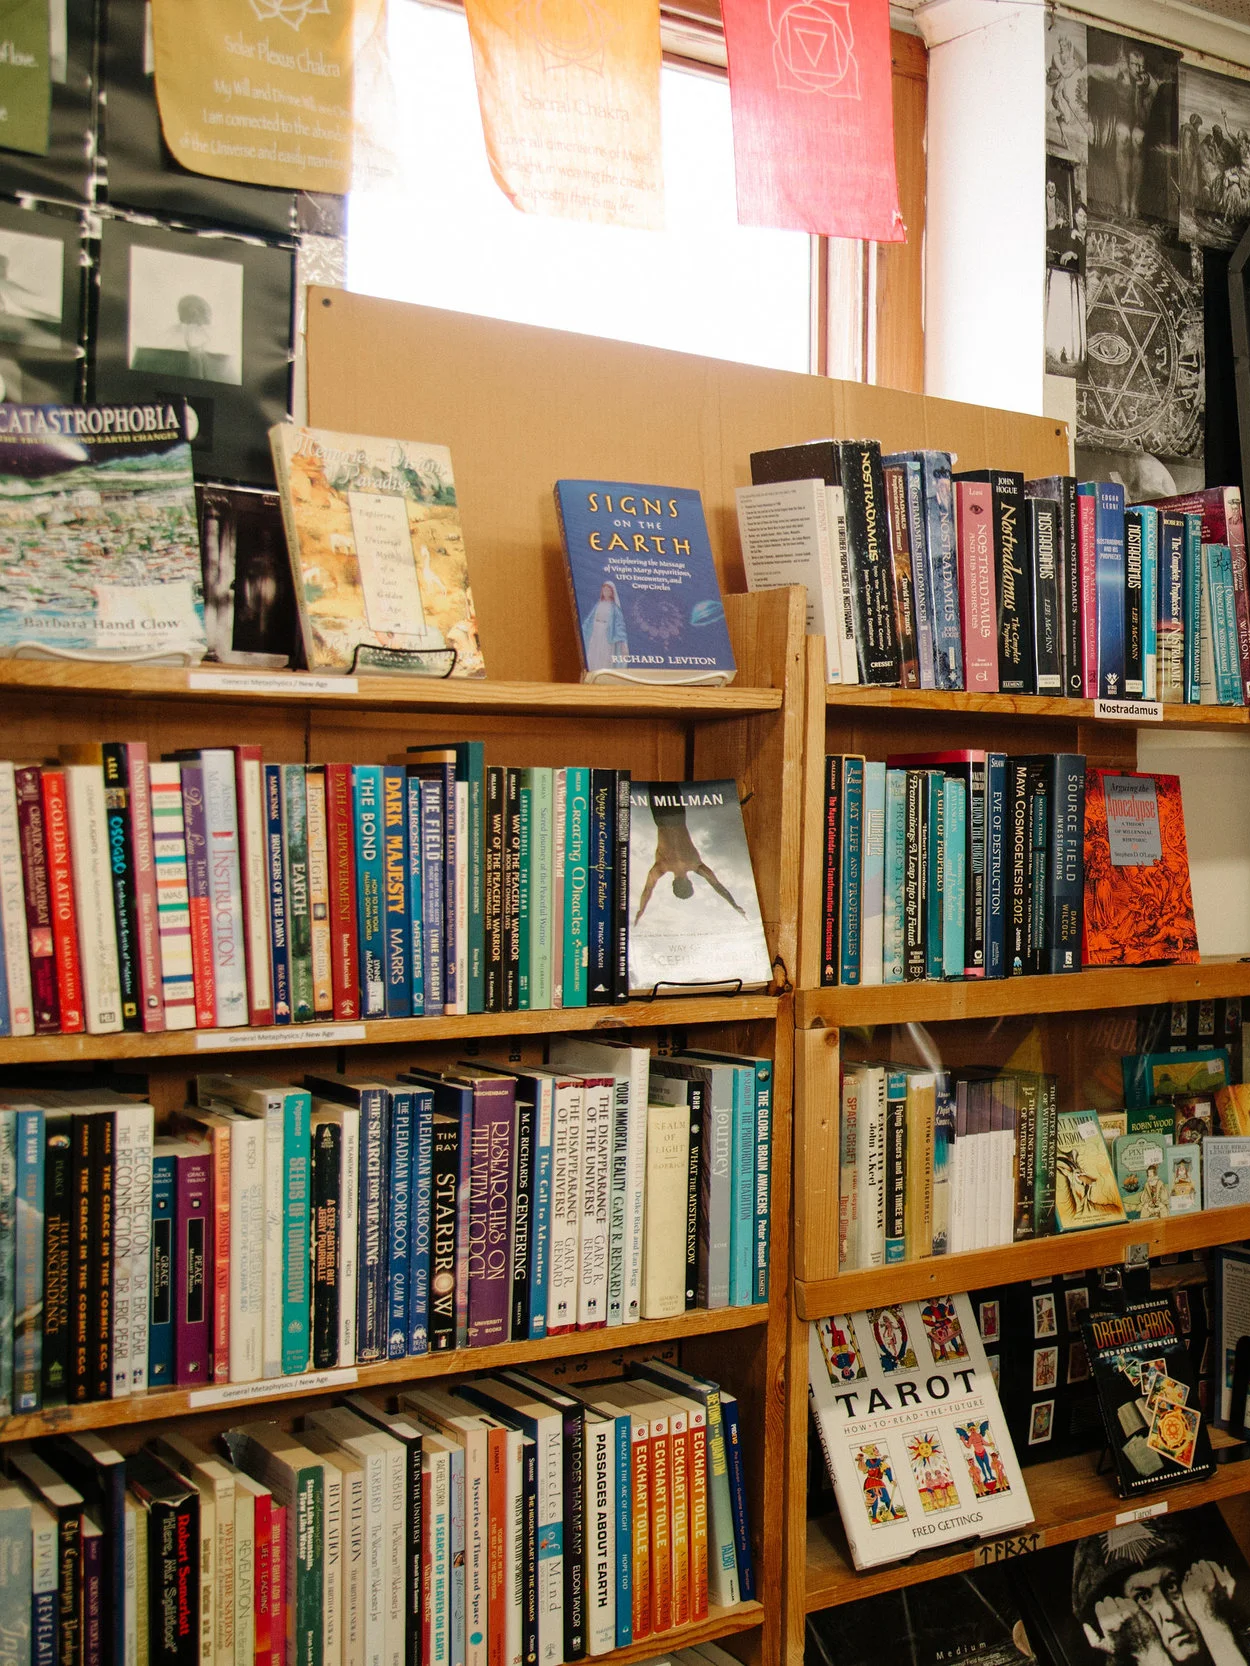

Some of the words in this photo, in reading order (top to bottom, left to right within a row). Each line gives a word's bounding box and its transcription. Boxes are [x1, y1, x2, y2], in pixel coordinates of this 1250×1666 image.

[296, 50, 341, 78] Chakra
[996, 485, 1018, 495] HOGUE
[998, 477, 1015, 485] JOHN
[587, 493, 679, 517] SIGNS
[860, 452, 879, 563] NOSTRADAMUS
[614, 519, 631, 528] ON
[638, 521, 662, 530] THE
[589, 532, 691, 556] EARTH
[1001, 501, 1023, 611] Nostradamus
[1038, 512, 1054, 580] NOSTRADAMUS
[648, 559, 658, 567] the
[659, 561, 685, 569] Message
[977, 524, 991, 638] NOSTRADAMUS
[23, 616, 87, 630] Barbara
[93, 618, 135, 630] Hand
[139, 618, 180, 631] Clow
[612, 655, 664, 664] RICHARD
[669, 656, 716, 665] LEVITON
[1099, 703, 1158, 716] Nostradamus
[359, 777, 375, 806] THE
[1016, 766, 1027, 798] MAYA
[384, 777, 404, 831] DARK
[654, 793, 724, 807] MILLMAN
[993, 791, 1002, 813] EVE
[1067, 774, 1078, 833] SOURCE
[1107, 793, 1156, 821] Apocalypse
[51, 796, 69, 867] GOLDEN
[360, 812, 377, 861] BOND
[492, 813, 501, 835] WAY
[993, 815, 1002, 831] OF
[492, 836, 501, 849] OF
[492, 850, 500, 867] THE
[1013, 800, 1026, 896] COSMOGENESIS
[385, 836, 405, 915] MAJESTY
[992, 833, 1001, 915] DESTRUCTION
[1066, 841, 1077, 882] FIELD
[56, 869, 70, 921] RATIO
[212, 849, 237, 968] INSTRUCTION
[491, 869, 501, 917] PEACEFUL
[1013, 898, 1024, 925] 2012
[491, 918, 501, 962] WARRIOR
[391, 928, 405, 986] MARRS
[758, 1109, 769, 1142] GLOBAL
[894, 1104, 903, 1127] Flying
[1131, 1121, 1153, 1131] ROBIN
[1154, 1119, 1174, 1127] WOOD
[435, 1143, 459, 1152] RAY
[437, 1132, 457, 1140] TIM
[714, 1107, 730, 1179] journey
[895, 1128, 903, 1159] Saucers
[757, 1145, 768, 1170] BRAIN
[756, 1174, 768, 1214] AWAKENS
[894, 1177, 903, 1192] THE
[514, 1195, 529, 1280] CENTERING
[1092, 1311, 1138, 1349] DREAM
[1140, 1309, 1175, 1337] CARDS
[1099, 1349, 1116, 1359] AND
[1117, 1344, 1143, 1355] ENRICH
[1144, 1340, 1163, 1350] YOUR
[1163, 1337, 1179, 1346] LIFE
[835, 1368, 976, 1418] TAROT
[596, 1433, 607, 1508] PASSAGES
[693, 1431, 705, 1493] ECKHART
[694, 1494, 705, 1539] TOLLE
[912, 1524, 936, 1538] FRED
[938, 1511, 984, 1532] GETTINGS
[1132, 1507, 1152, 1520] Tarot
[178, 1513, 190, 1562] Robert
[597, 1512, 607, 1558] ABOUT
[178, 1566, 191, 1636] Somerlott
[597, 1562, 607, 1608] EARTH
[936, 1641, 986, 1660] Medium
